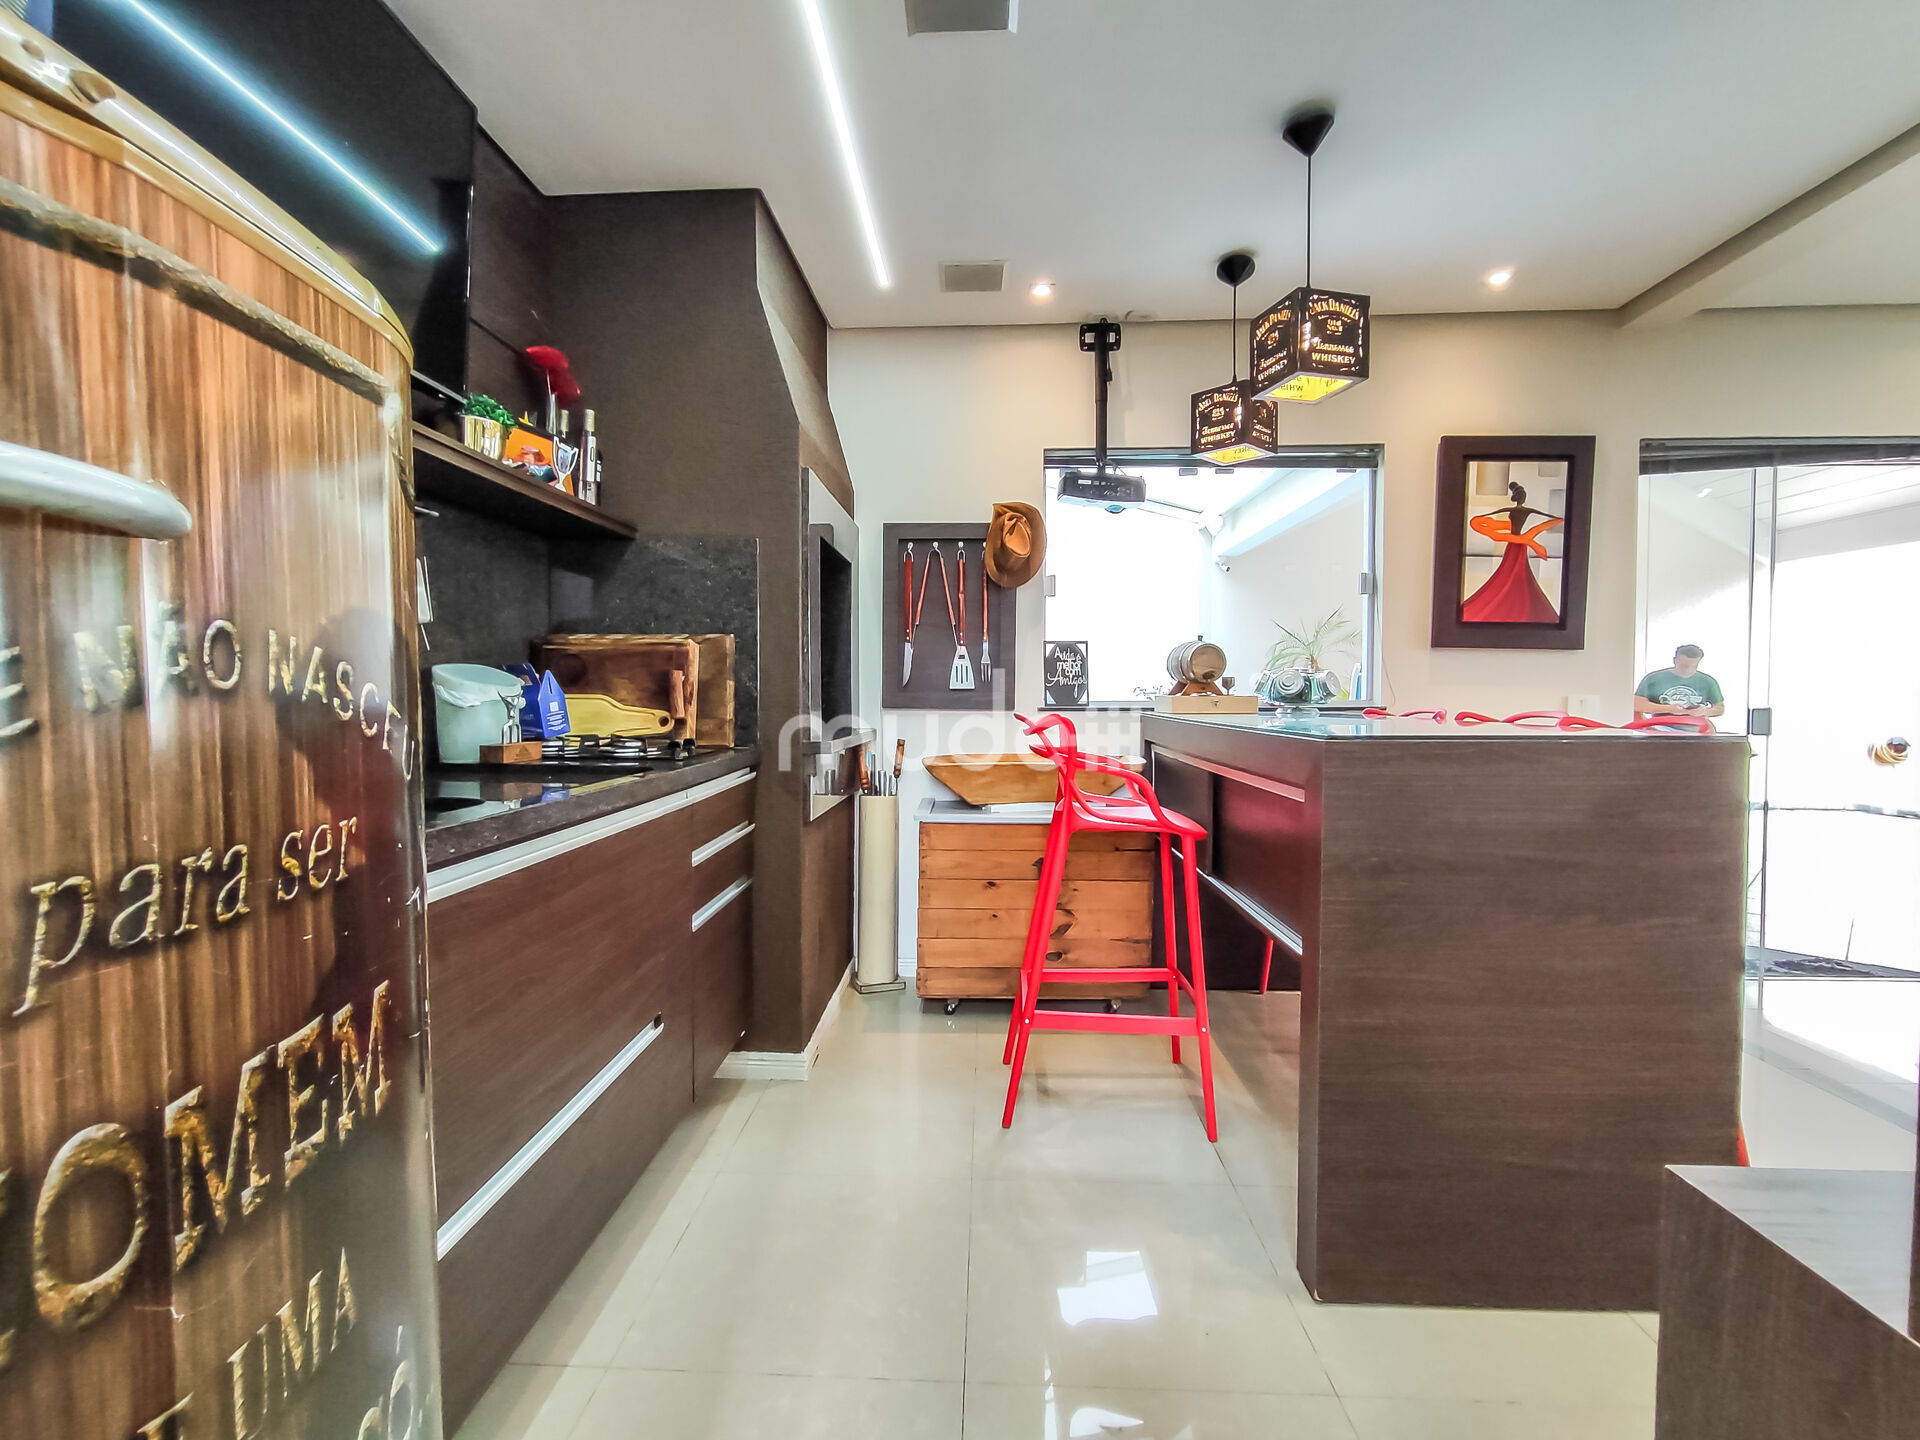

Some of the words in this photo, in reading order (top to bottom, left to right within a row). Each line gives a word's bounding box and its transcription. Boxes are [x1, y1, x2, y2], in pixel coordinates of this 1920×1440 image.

[1309, 301, 1329, 315] JACK
[1311, 352, 1356, 365] WHISKEY
[1200, 430, 1236, 444] WHISKEY
[11, 843, 251, 1017] para
[277, 816, 358, 902] ser
[0, 979, 392, 1367] OMEM
